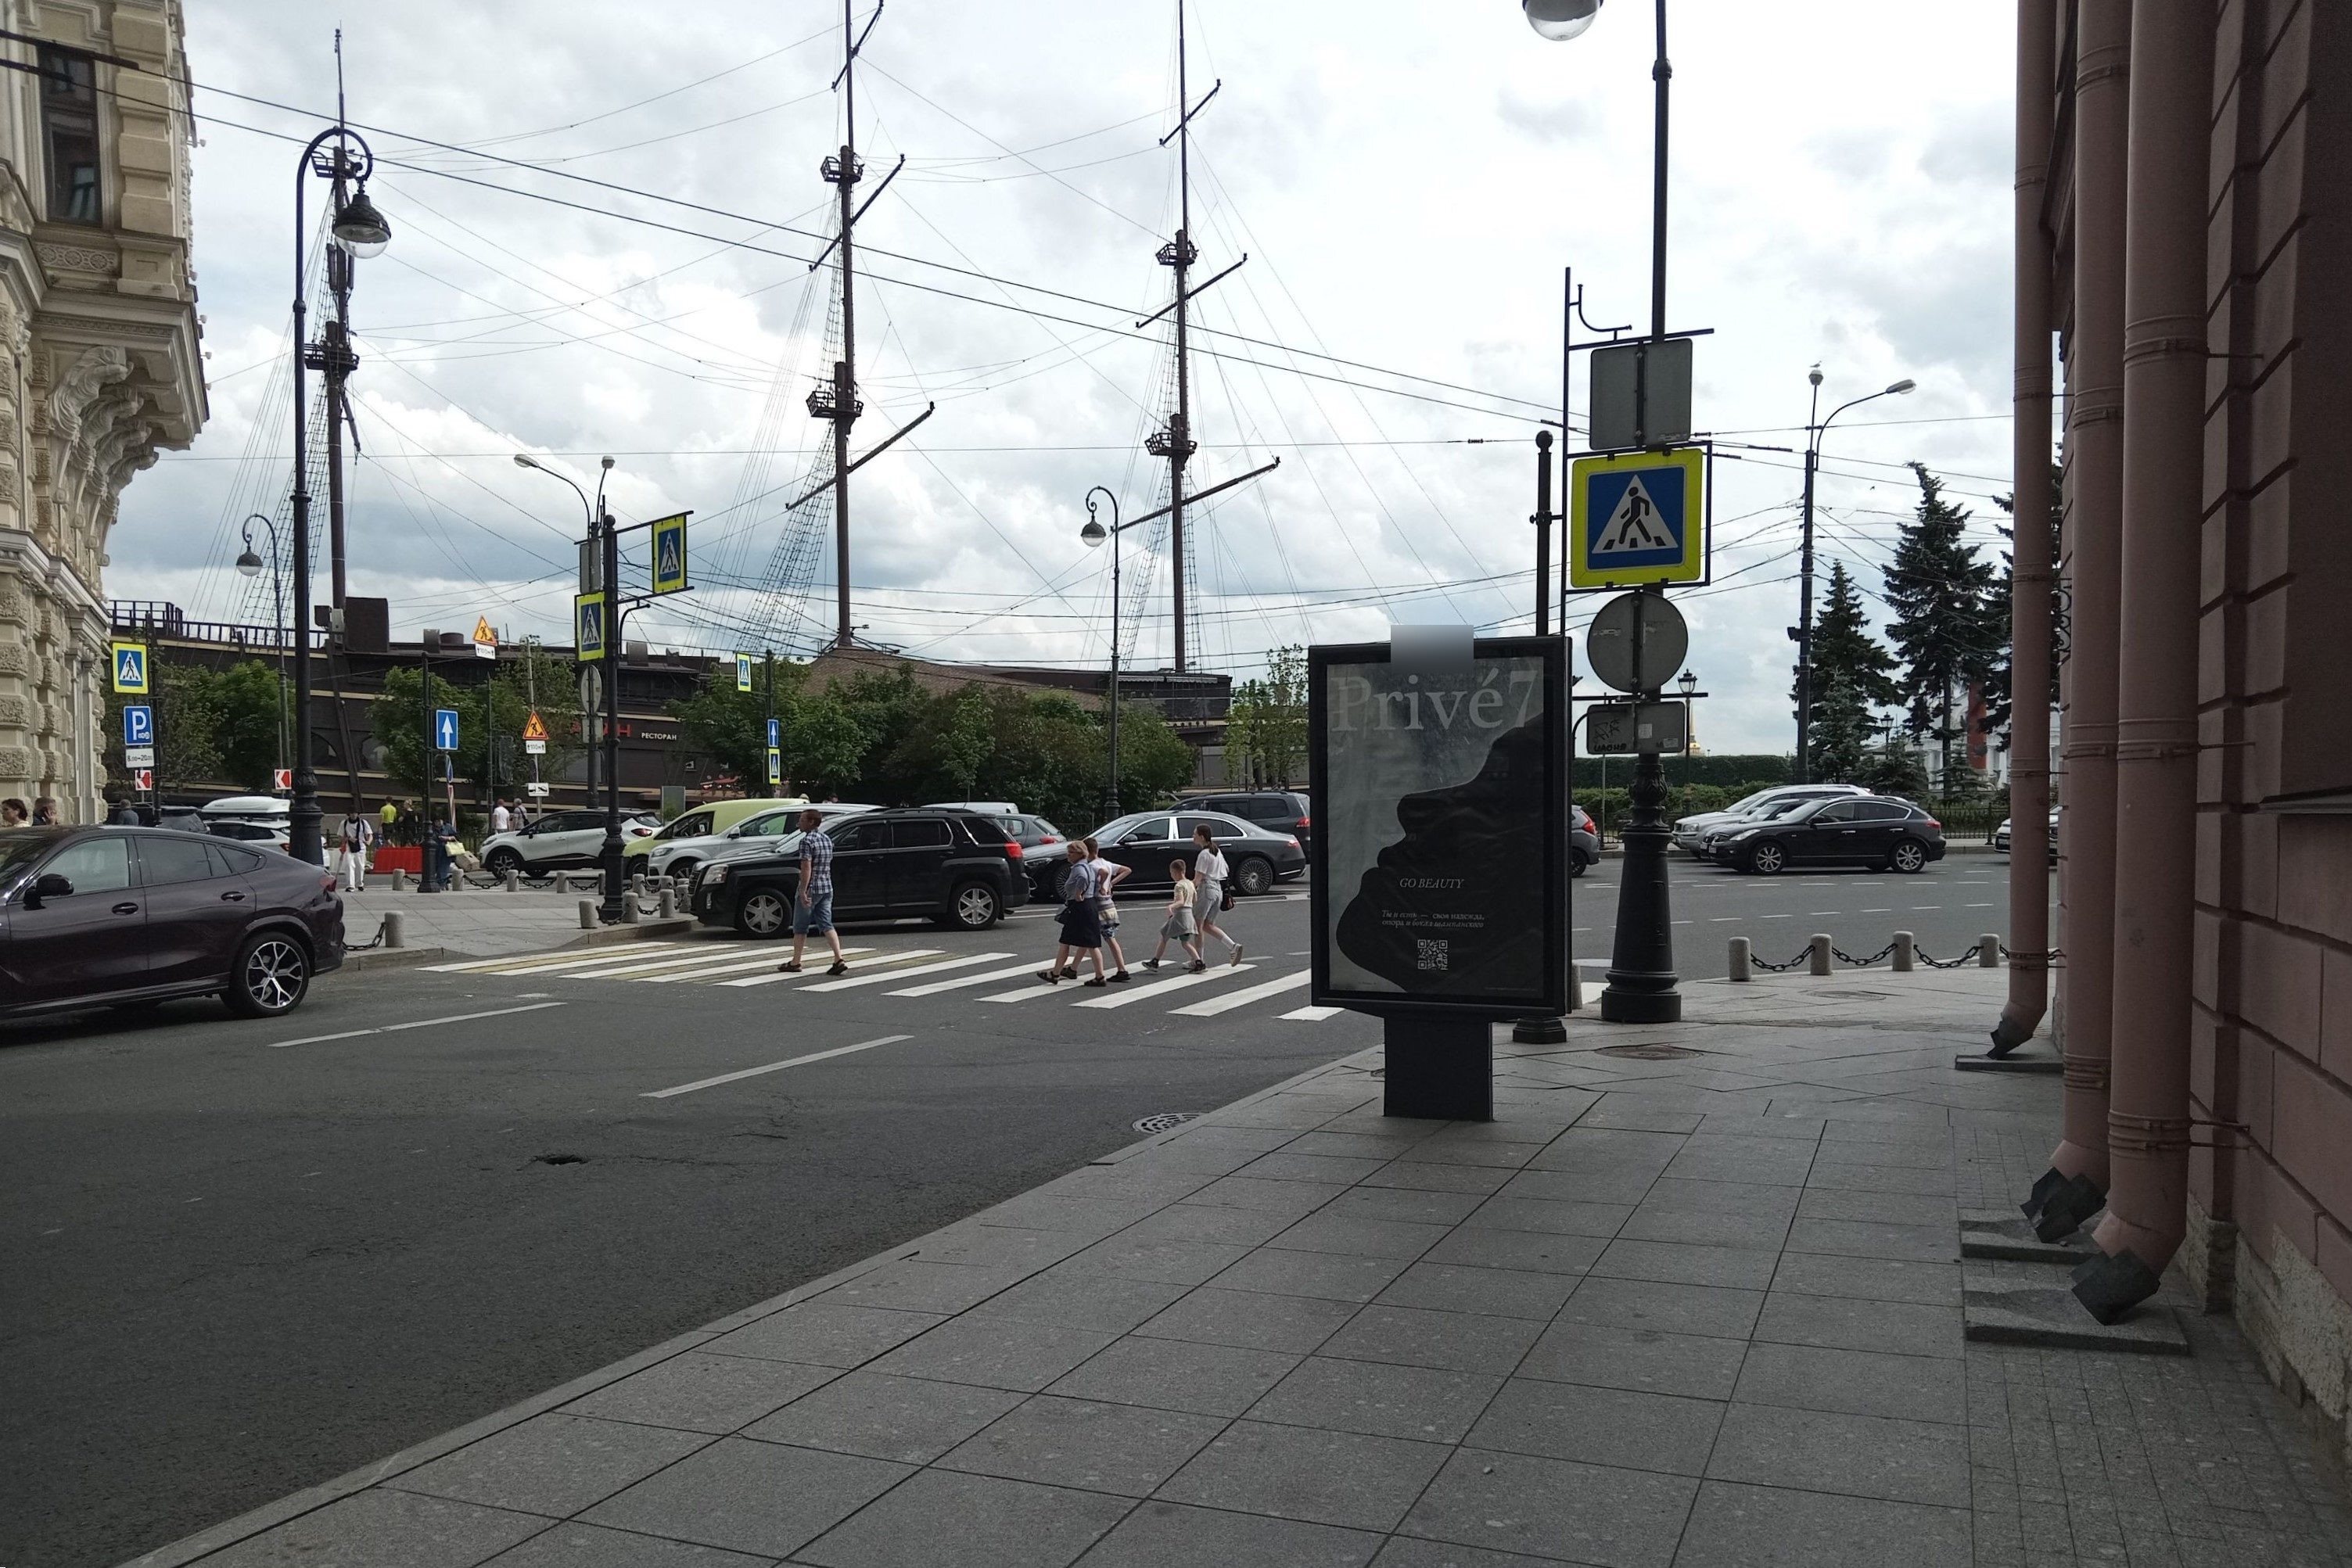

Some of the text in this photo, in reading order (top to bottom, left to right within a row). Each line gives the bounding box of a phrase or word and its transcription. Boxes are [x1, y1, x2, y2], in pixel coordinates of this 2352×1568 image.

[1330, 667, 1538, 731] Privé7
[131, 711, 147, 741] P
[641, 732, 677, 741] РЕСТОРАН
[1399, 877, 1465, 889] GO BEAUTY
[1381, 920, 1404, 928] опора
